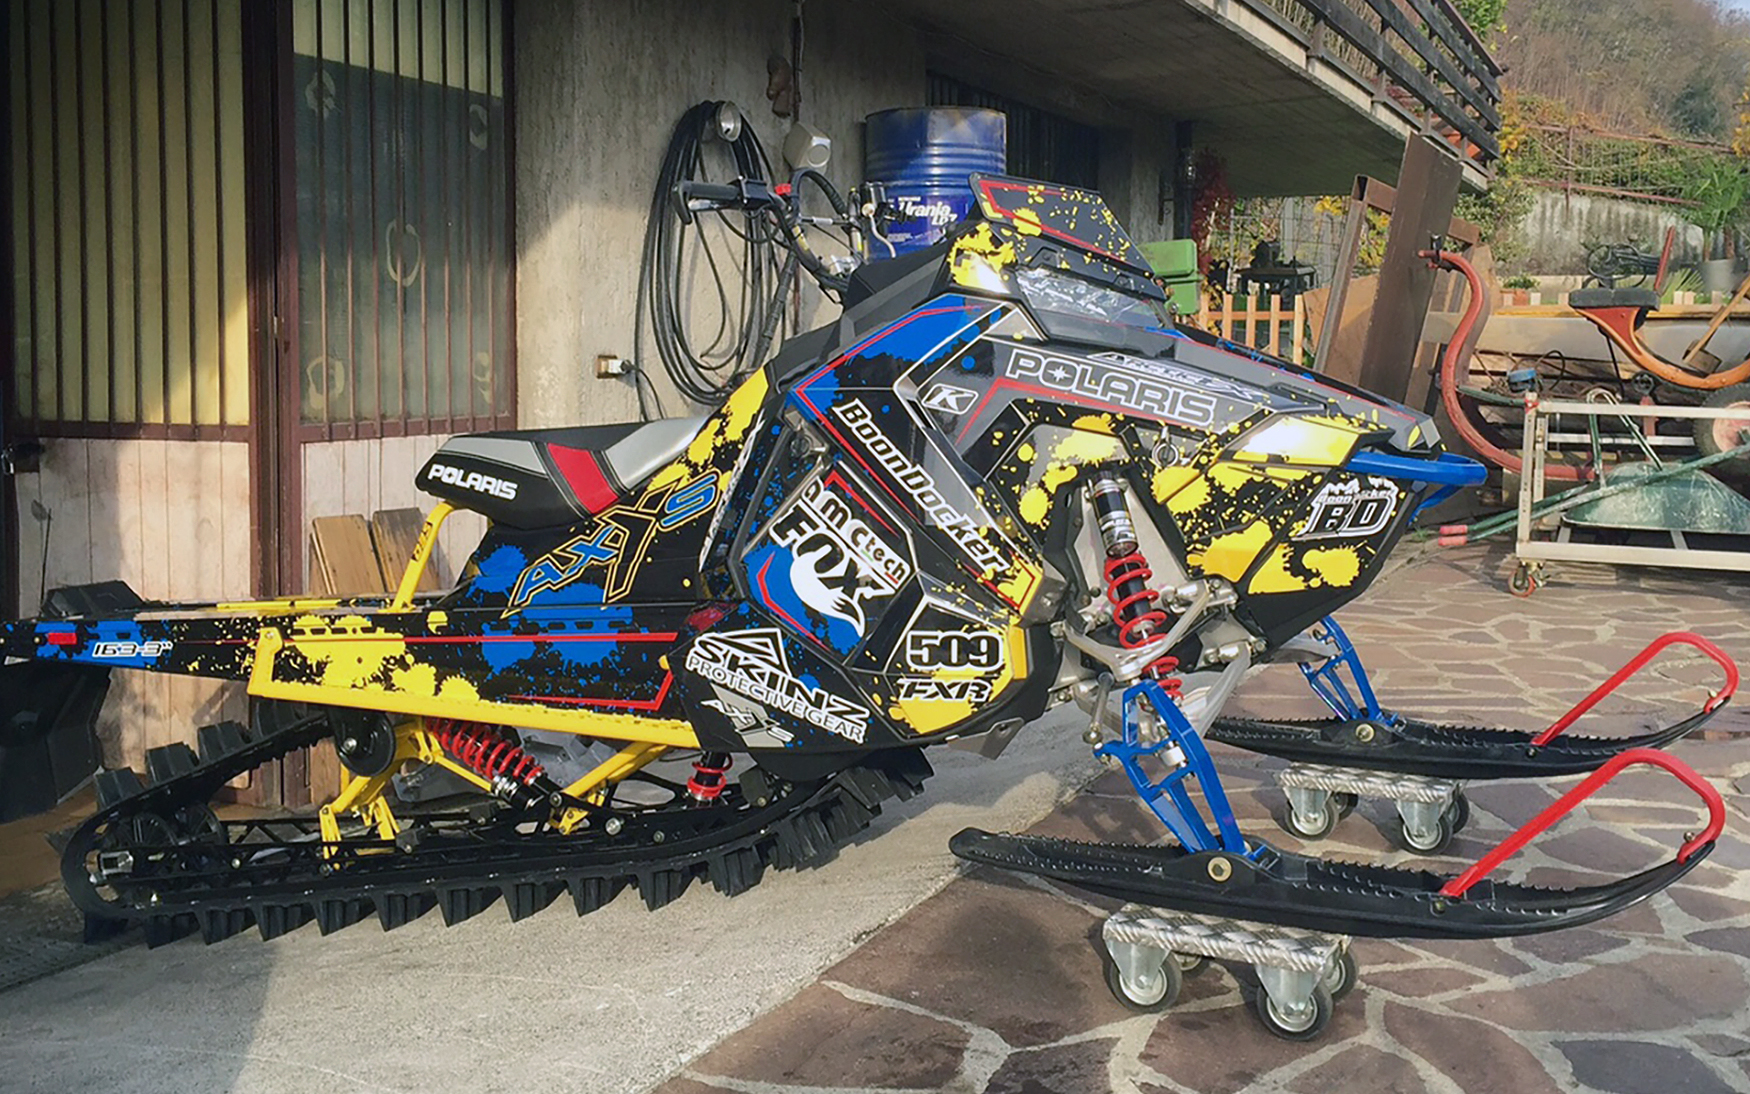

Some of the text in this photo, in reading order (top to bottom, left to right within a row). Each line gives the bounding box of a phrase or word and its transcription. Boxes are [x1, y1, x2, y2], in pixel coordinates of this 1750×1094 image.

[1005, 348, 1218, 426] POLARIS
[427, 464, 518, 500] POLARIS
[769, 500, 895, 604] FOX
[695, 635, 869, 729] SKINZ
[906, 630, 1003, 672] 509
[686, 654, 866, 744] PROTECTIVE GEAR
[898, 679, 992, 702] FXR
